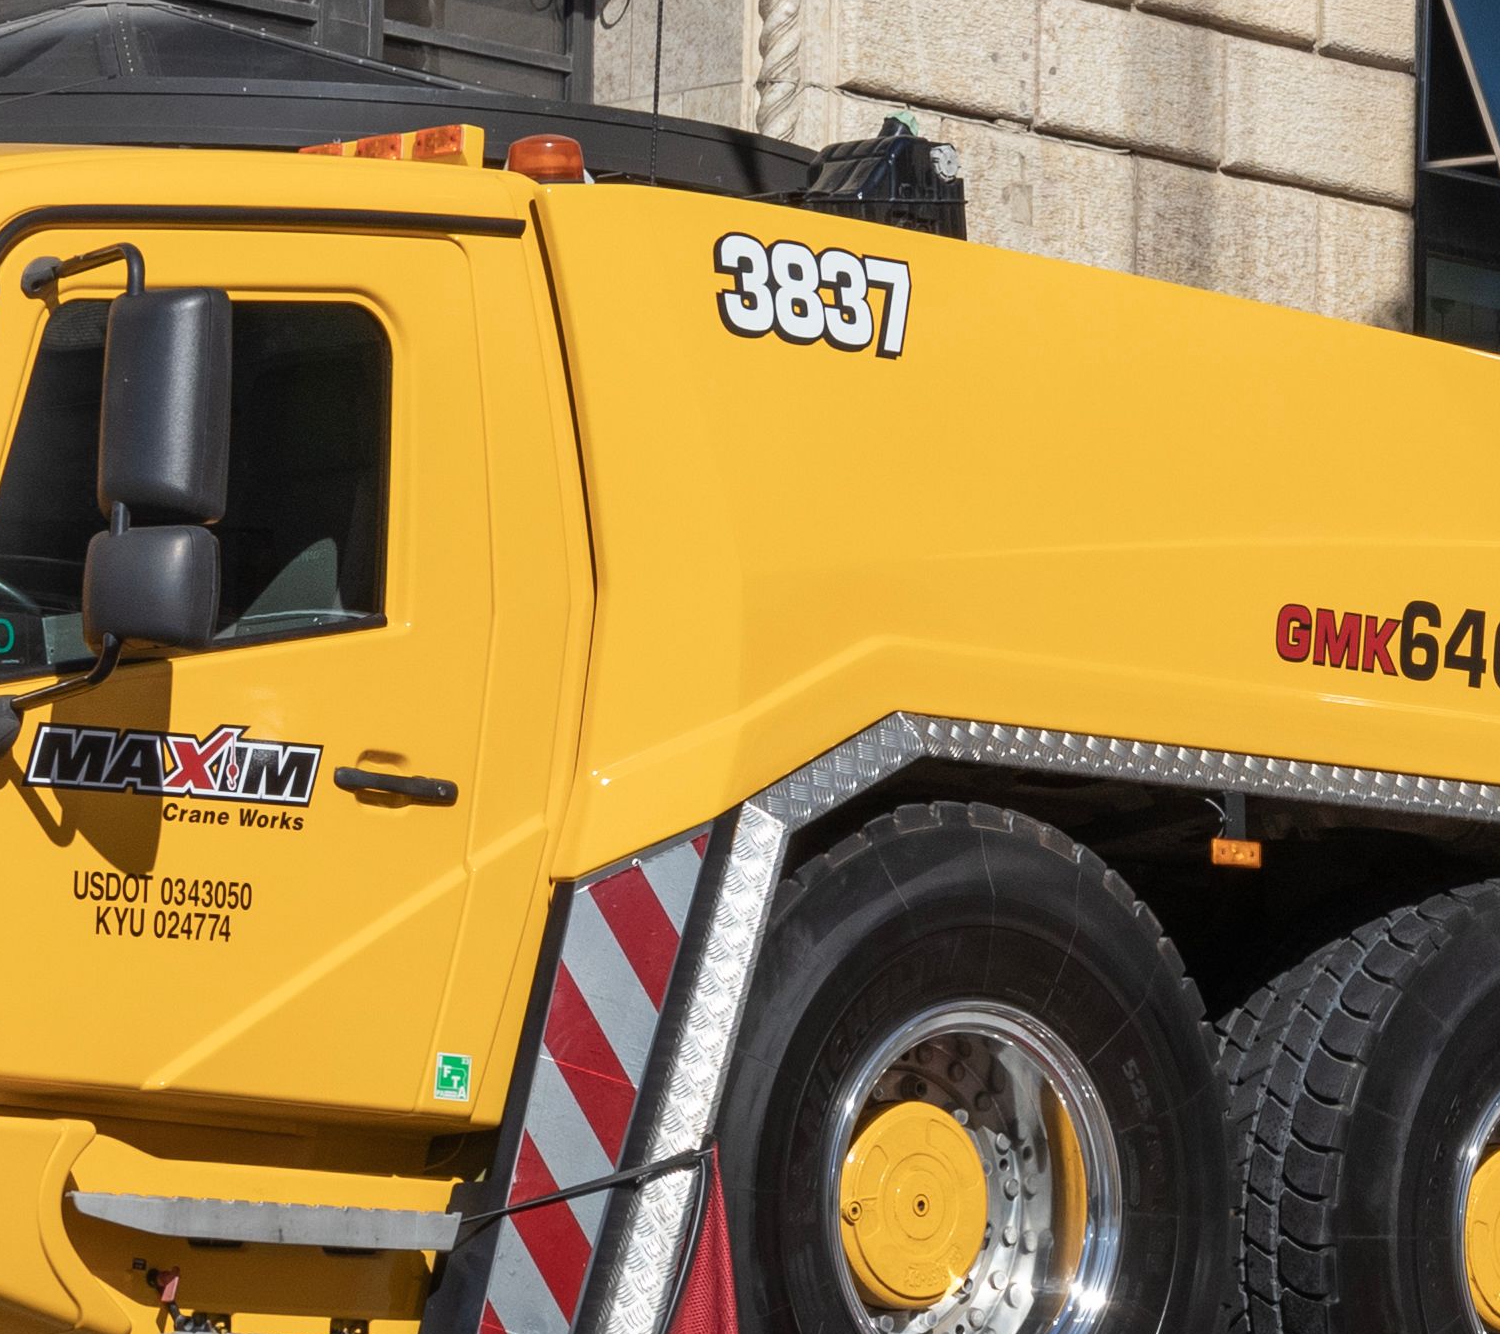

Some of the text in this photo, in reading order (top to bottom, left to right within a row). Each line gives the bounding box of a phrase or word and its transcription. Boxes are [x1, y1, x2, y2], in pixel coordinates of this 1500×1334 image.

[713, 232, 912, 360] 3837
[25, 724, 323, 806] MAXIM
[163, 802, 305, 831] Crane Works
[73, 870, 253, 911] USDOT 0343050
[95, 905, 231, 942] KYU 024774
